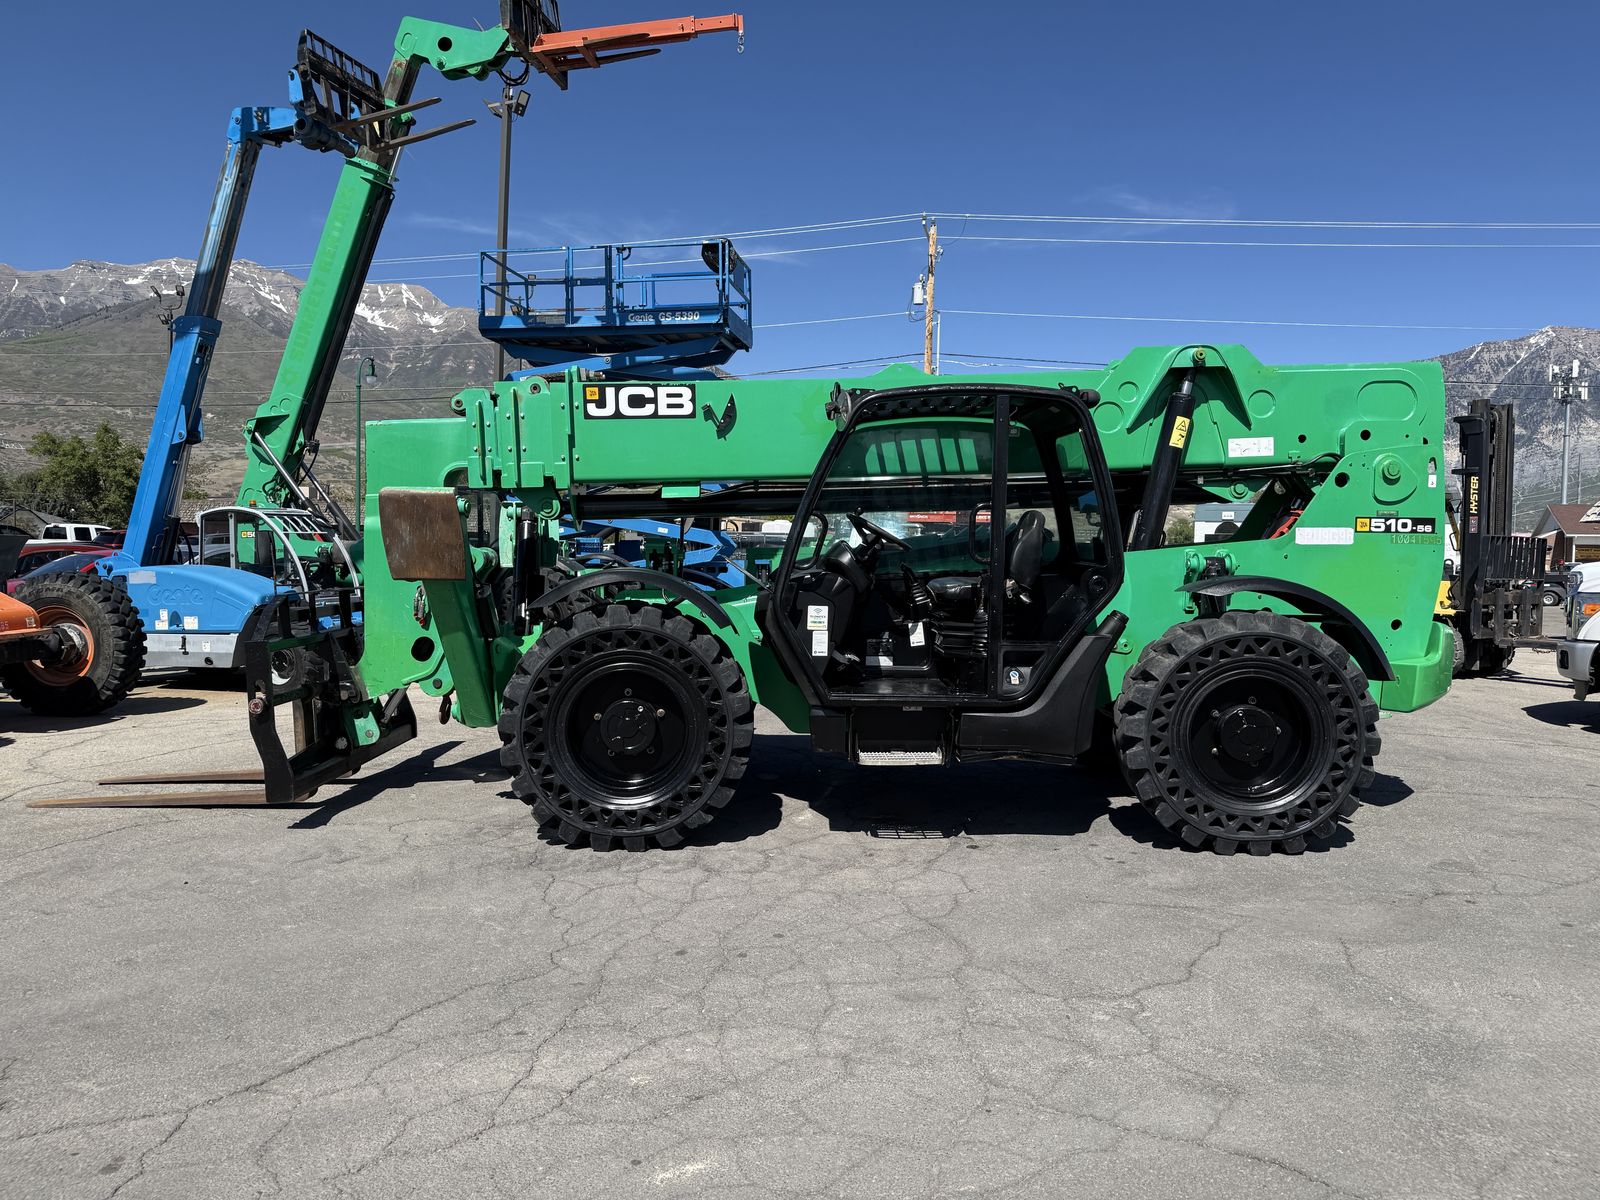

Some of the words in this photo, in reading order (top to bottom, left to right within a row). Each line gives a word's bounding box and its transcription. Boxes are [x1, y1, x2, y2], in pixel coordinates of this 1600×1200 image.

[628, 312, 654, 322] Genie
[586, 386, 694, 417] JCB
[1469, 476, 1479, 514] HYSTER
